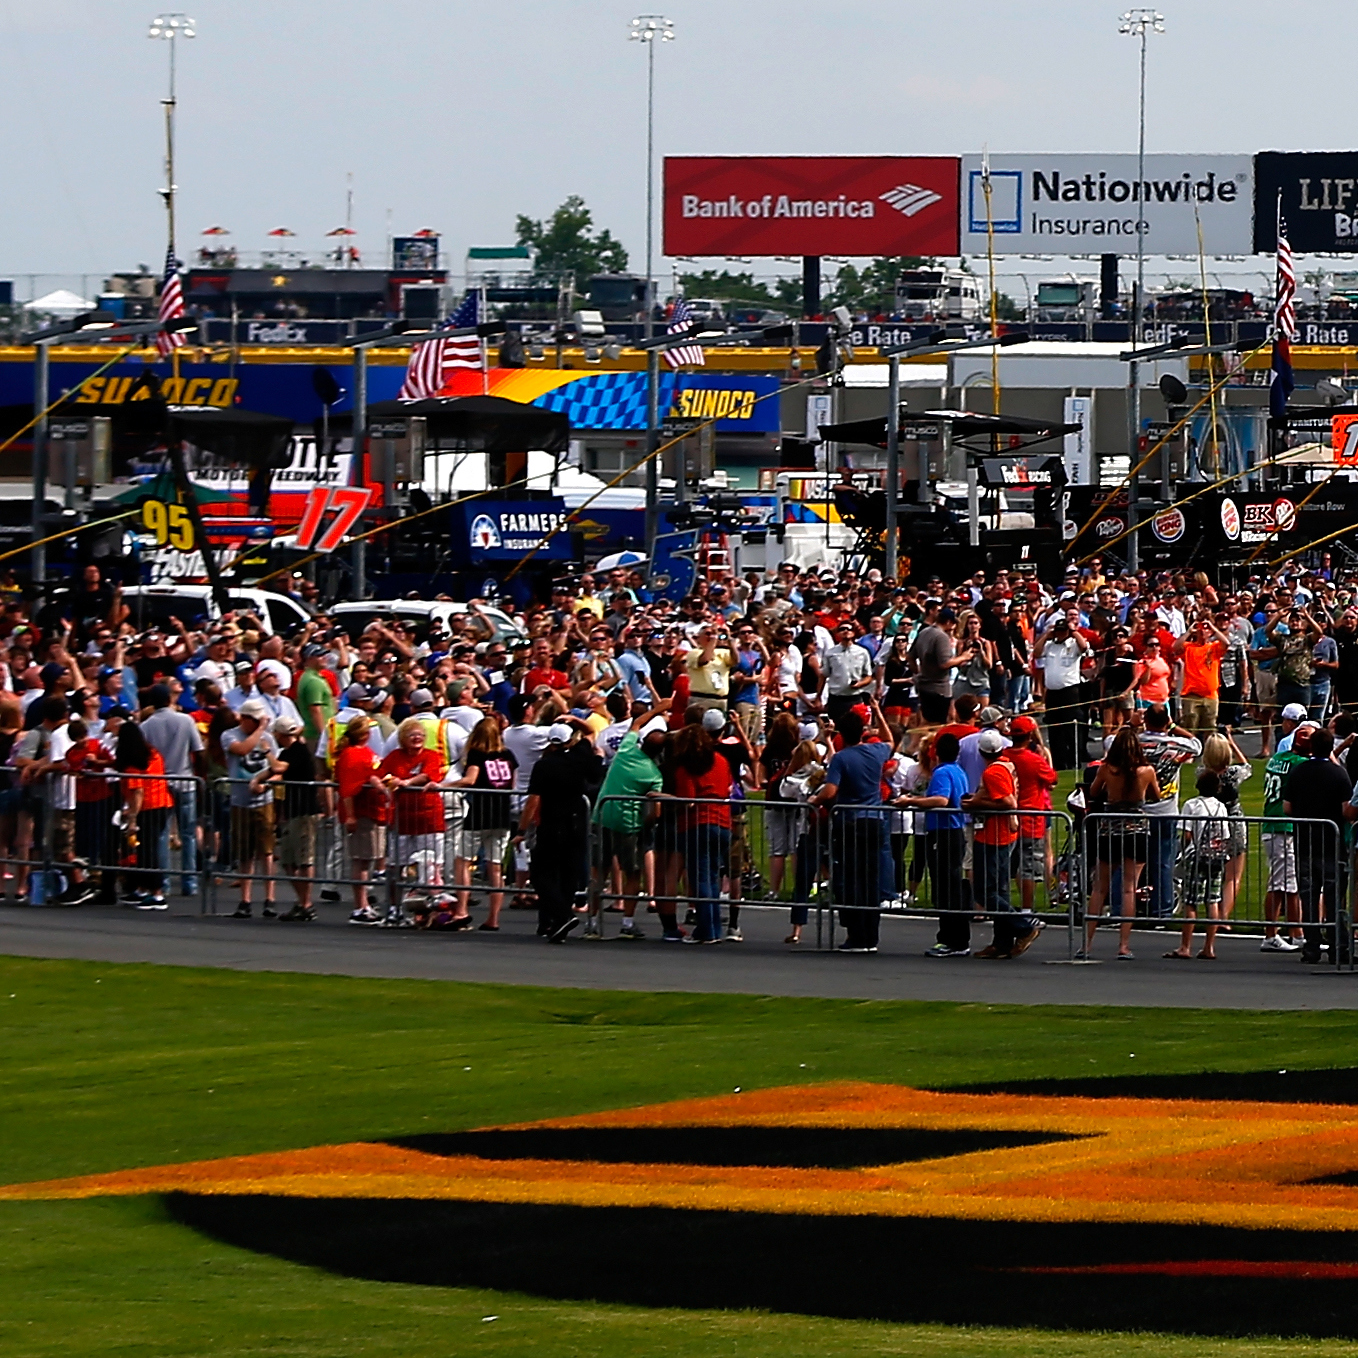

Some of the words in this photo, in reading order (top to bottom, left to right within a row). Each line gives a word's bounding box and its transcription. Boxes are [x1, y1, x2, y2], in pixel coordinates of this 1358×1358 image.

[1032, 171, 1238, 203] Nationwide
[683, 195, 743, 218] Bank
[747, 195, 771, 218] of
[774, 195, 875, 218] America
[1032, 213, 1150, 236] Insurance
[249, 324, 307, 342] FedEx
[868, 327, 911, 346] Rate
[1143, 324, 1190, 342] edEx
[1266, 325, 1301, 343] Oe
[1306, 325, 1349, 343] Rate
[680, 388, 756, 420] SUNOCO
[1244, 505, 1273, 523] BK
[1327, 502, 1345, 512] Row
[142, 500, 195, 551] 95
[295, 484, 373, 553] 17
[500, 513, 568, 533] FARMERS
[1157, 521, 1181, 531] KING
[485, 760, 512, 781] 88
